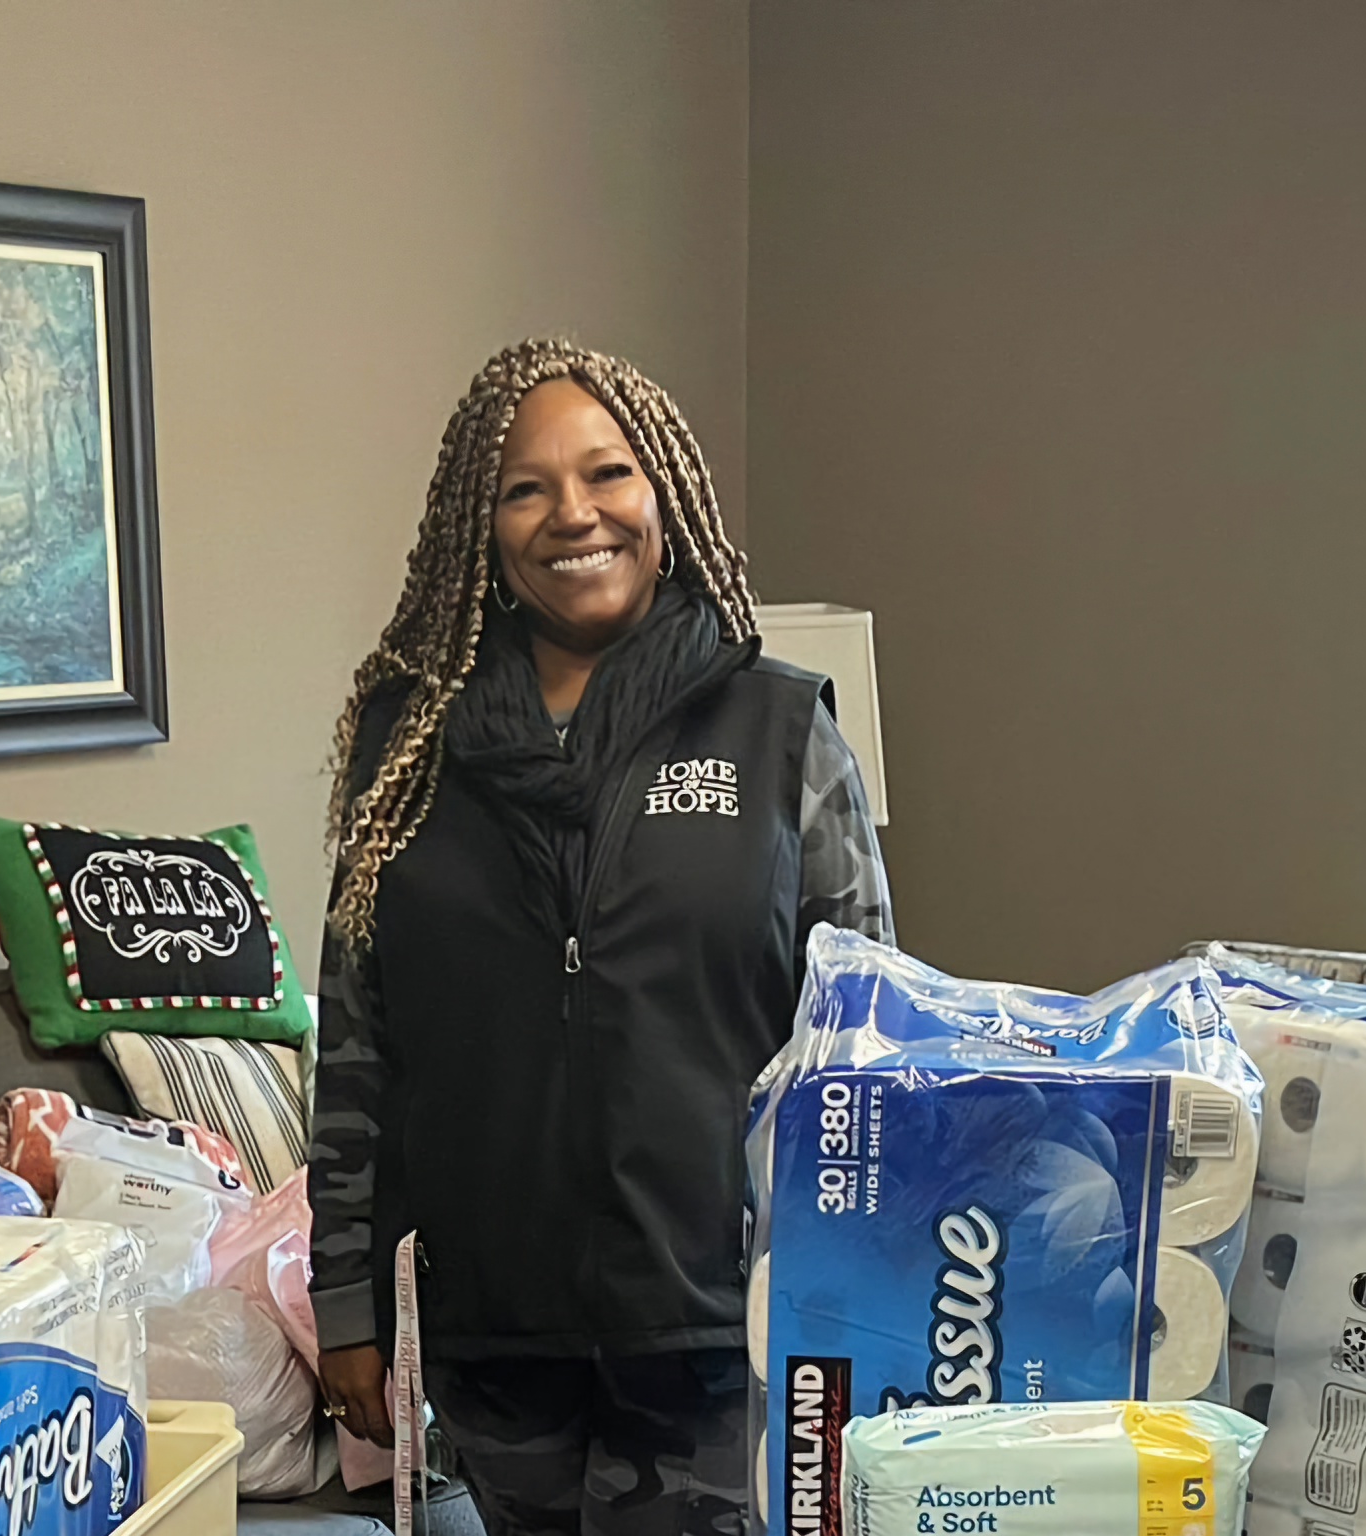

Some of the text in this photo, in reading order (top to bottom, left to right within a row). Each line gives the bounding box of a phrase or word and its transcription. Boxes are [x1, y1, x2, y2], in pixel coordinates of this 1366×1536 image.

[644, 788, 739, 816] HOPE
[101, 877, 226, 917] FA LA LA
[817, 1082, 851, 1215] 30 380
[865, 1085, 883, 1215] WIDE SHEETS
[916, 1485, 1056, 1508] Absorbent
[1181, 1477, 1206, 1511] 5
[917, 1512, 998, 1534] & Soft
